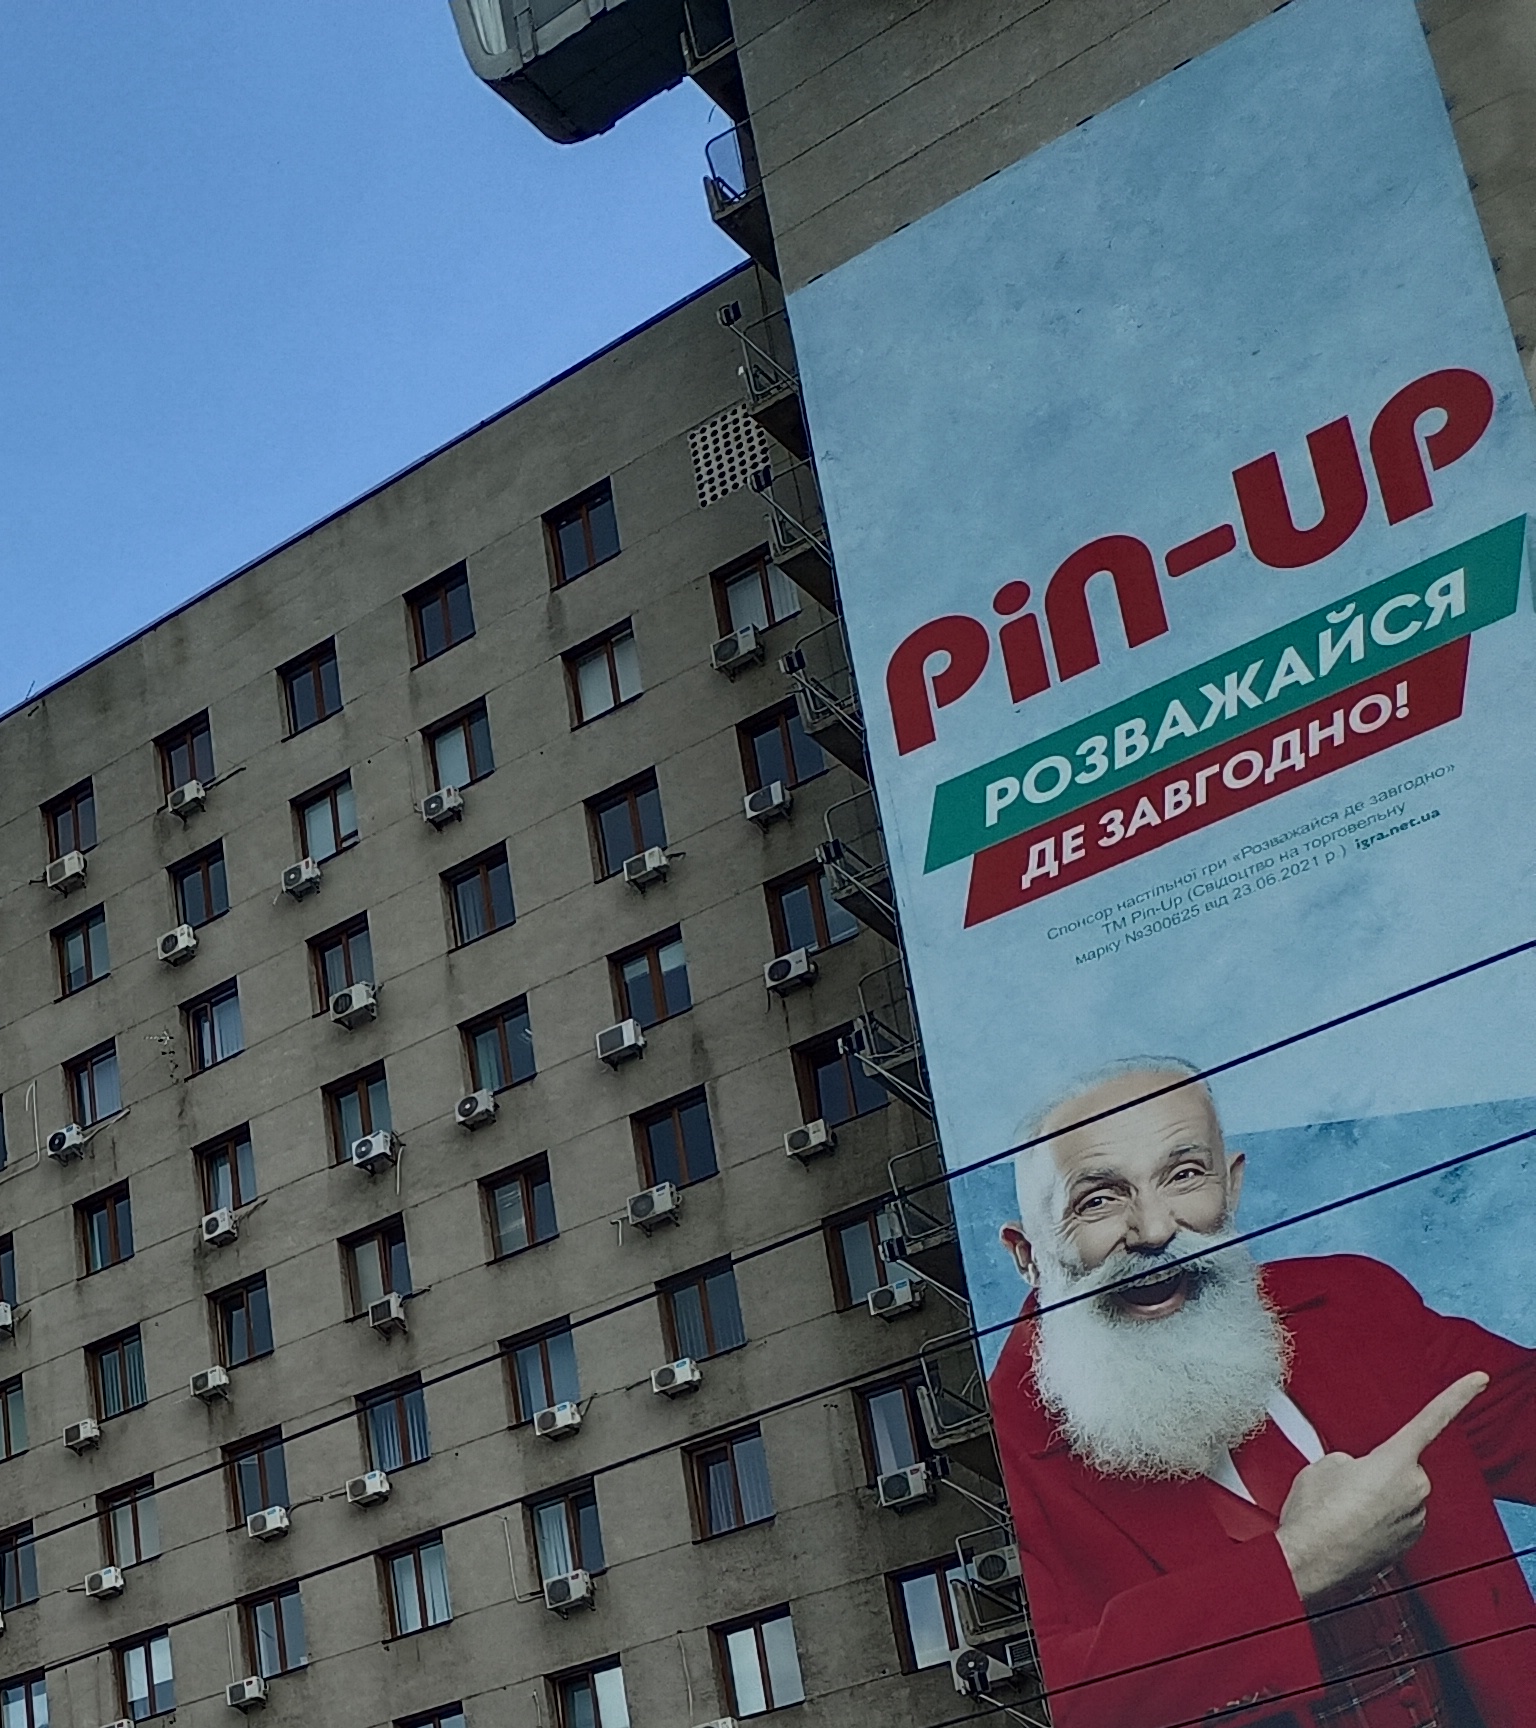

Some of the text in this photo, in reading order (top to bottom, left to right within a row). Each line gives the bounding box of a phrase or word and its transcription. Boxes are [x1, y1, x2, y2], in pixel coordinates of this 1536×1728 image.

[983, 566, 1469, 828] РОЗВАЖАЙСЯ
[1019, 680, 1411, 890] ДЕ ЗАВГОДНО!
[1046, 906, 1114, 942] Спонсор
[1117, 869, 1200, 914] настільної
[1201, 858, 1228, 882] гри
[1342, 800, 1366, 821] де
[1074, 940, 1122, 967] марку
[1125, 904, 1201, 944] №300625
[1232, 854, 1322, 902] 23.06.2021
[1354, 807, 1442, 852] igra.net.ua
[1131, 895, 1184, 929] Pin-Up
[1186, 856, 1276, 905] (Свідоцтво
[1279, 848, 1301, 865] на
[1302, 802, 1407, 857] торговельну
